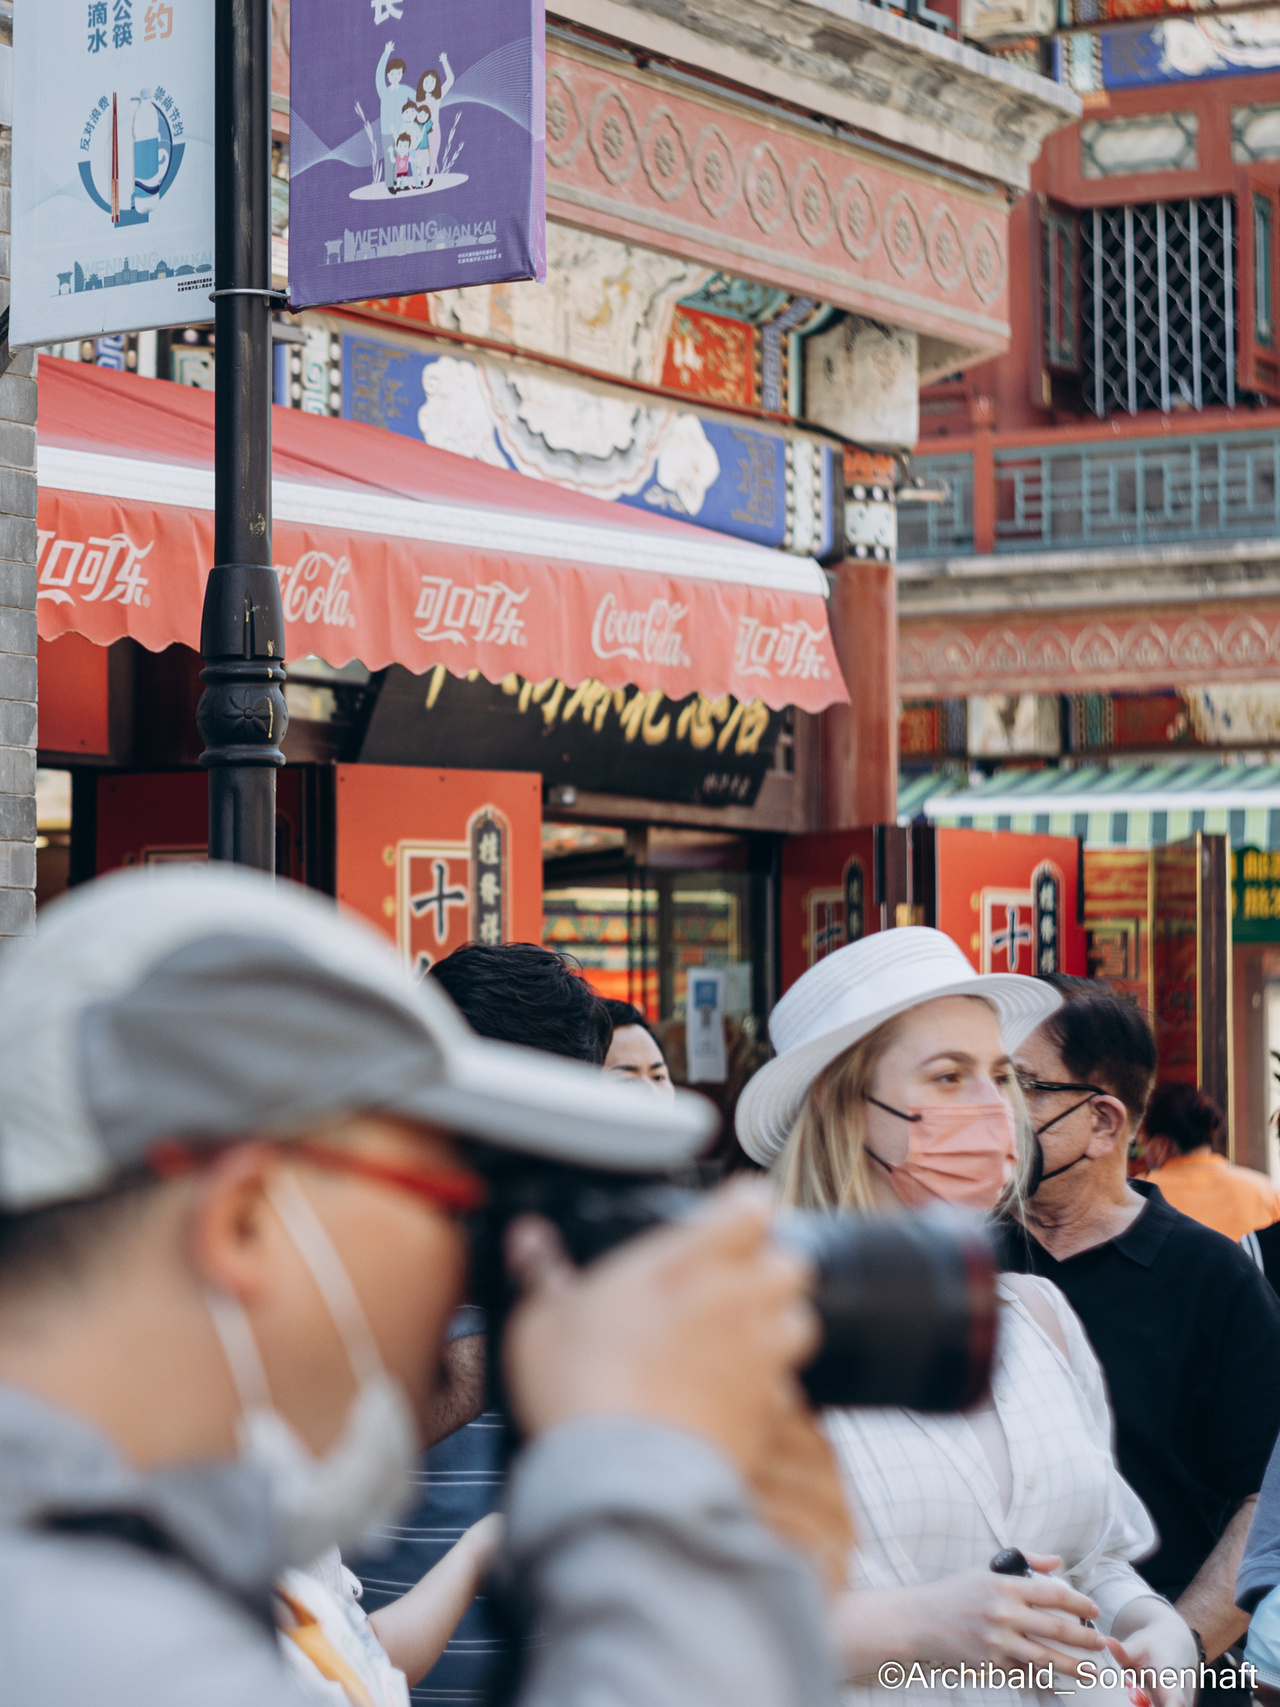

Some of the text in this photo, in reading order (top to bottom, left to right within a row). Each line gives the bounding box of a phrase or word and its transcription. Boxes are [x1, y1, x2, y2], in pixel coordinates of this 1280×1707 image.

[87, 2, 108, 54] 滴水
[112, 0, 133, 49] 公筷
[80, 95, 110, 152] 反对浪费
[153, 85, 184, 137] 崇尚节约
[474, 220, 496, 235] KAI
[414, 575, 530, 647] 可口可乐
[733, 616, 828, 681] 可口可乐
